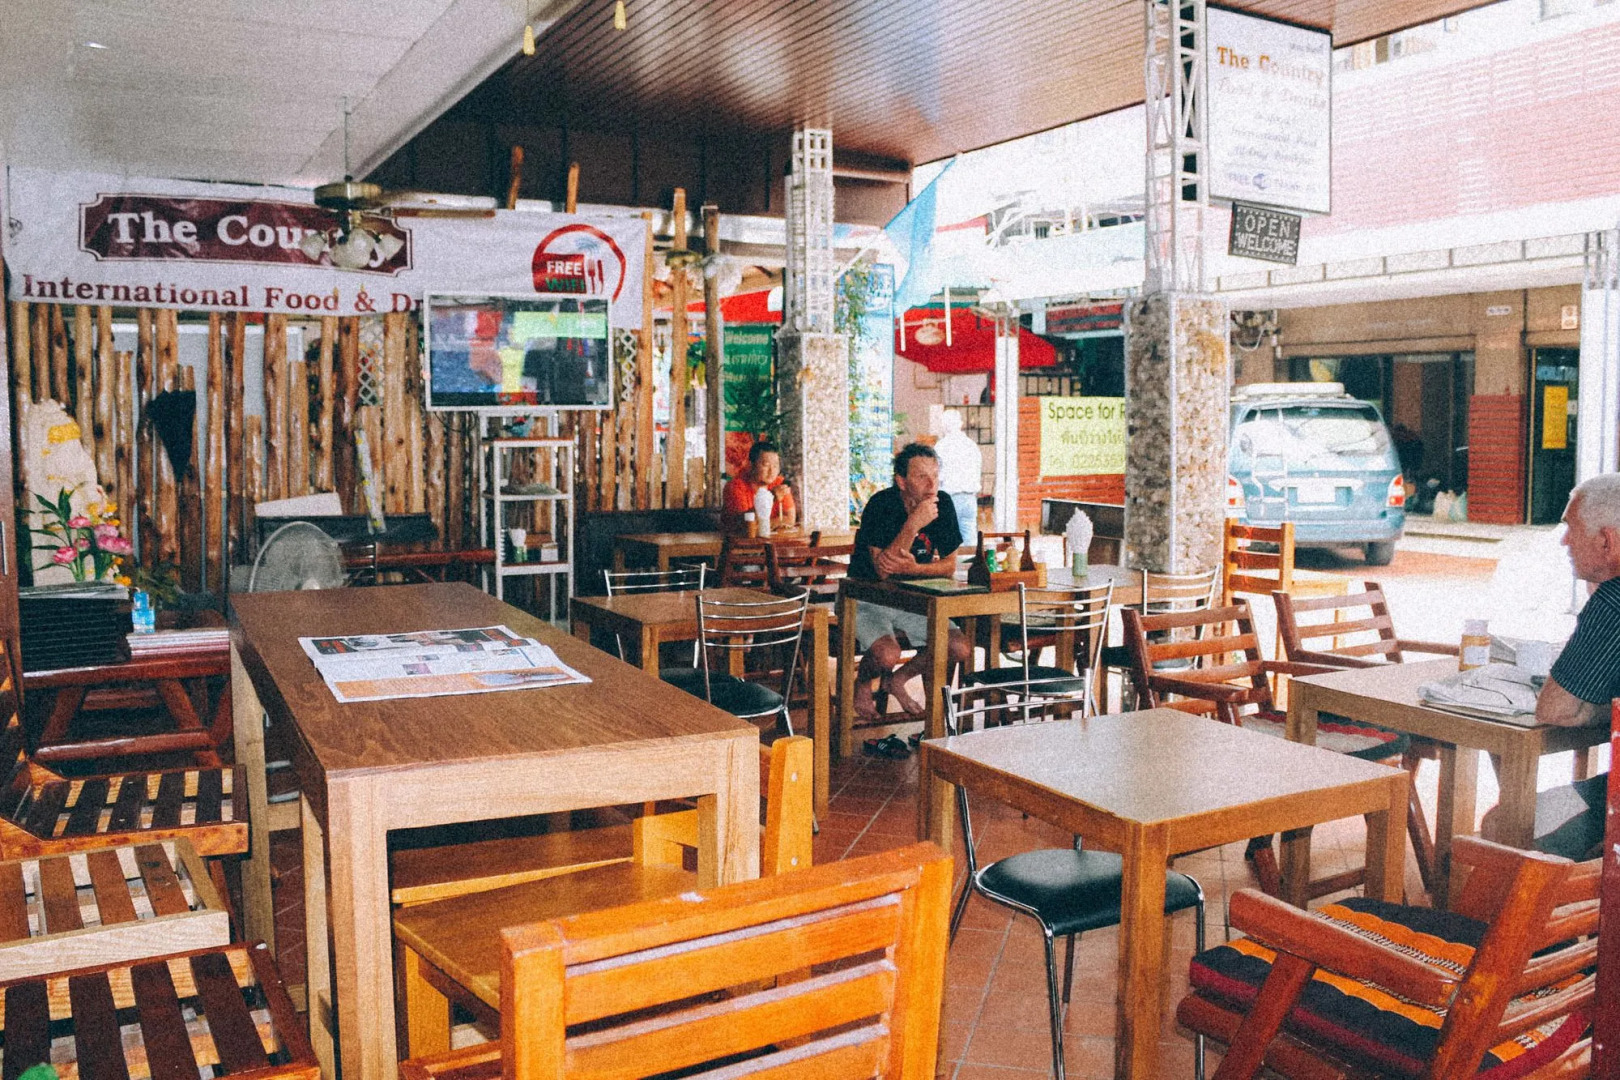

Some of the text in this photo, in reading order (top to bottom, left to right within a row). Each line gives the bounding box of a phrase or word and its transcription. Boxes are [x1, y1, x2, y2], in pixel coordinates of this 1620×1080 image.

[1217, 46, 1249, 69] The
[108, 212, 197, 244] The
[1244, 214, 1291, 238] OPEN
[1236, 232, 1296, 256] WELCOME
[546, 260, 583, 276] FREE
[22, 274, 249, 308] International
[265, 287, 339, 311] Food
[354, 291, 376, 312] &
[1048, 402, 1094, 422] Space
[1098, 403, 1115, 419] for
